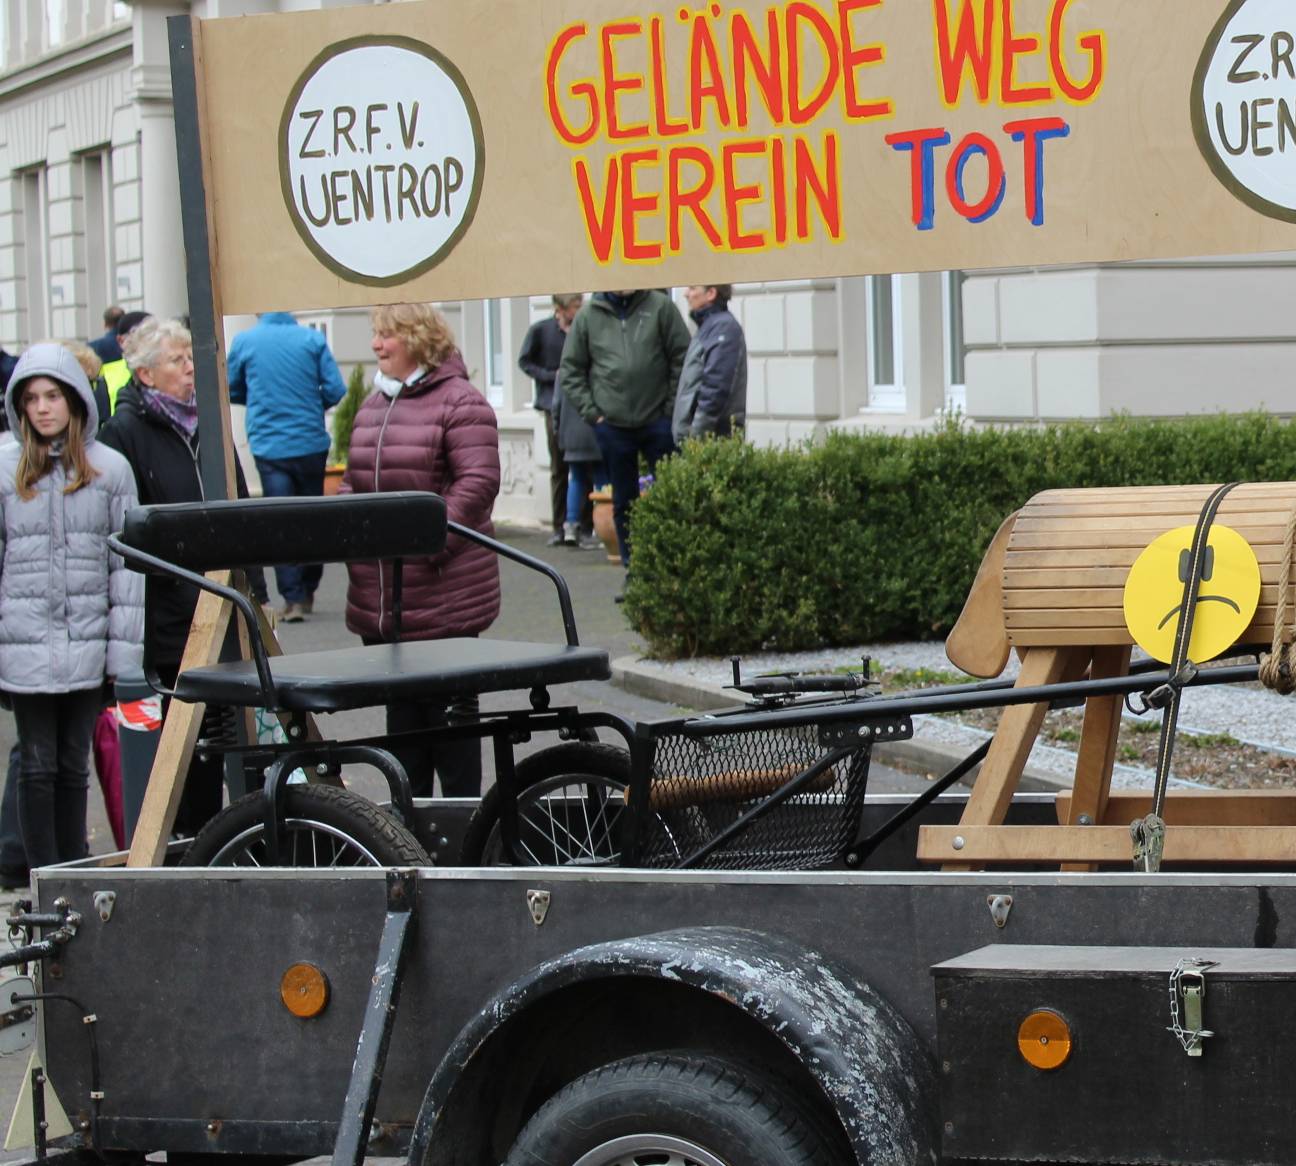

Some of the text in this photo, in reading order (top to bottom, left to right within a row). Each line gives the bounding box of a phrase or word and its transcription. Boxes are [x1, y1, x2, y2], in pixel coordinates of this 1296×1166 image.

[544, 0, 1105, 147] GELÄNDE WEG
[298, 100, 425, 160] Z.R.F.V.
[299, 155, 465, 228] UENTROP
[572, 116, 1071, 265] VEREIN TOT
